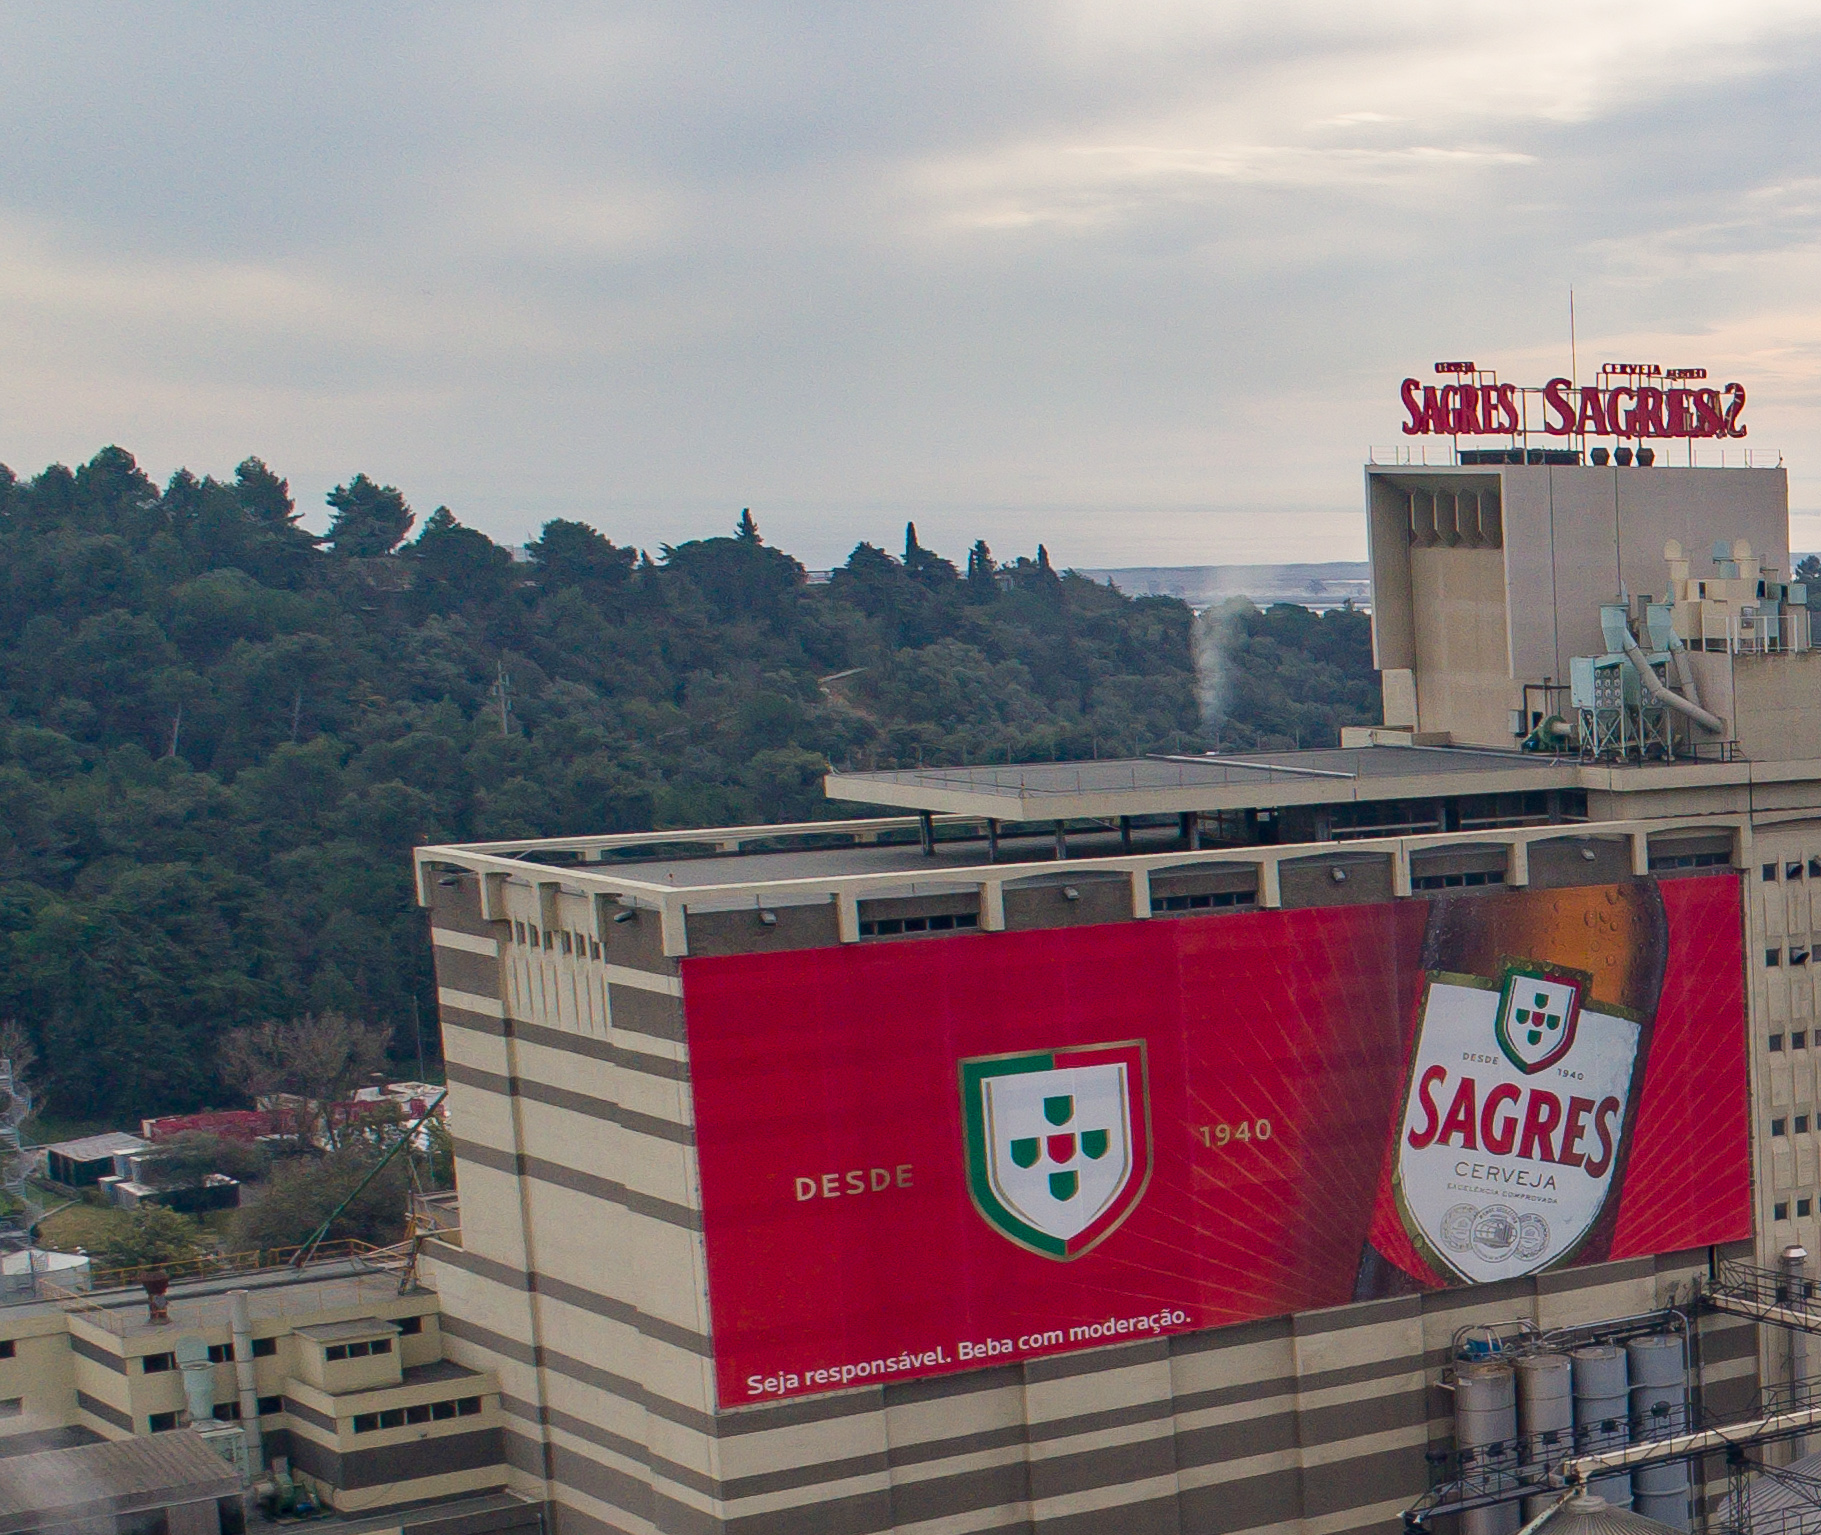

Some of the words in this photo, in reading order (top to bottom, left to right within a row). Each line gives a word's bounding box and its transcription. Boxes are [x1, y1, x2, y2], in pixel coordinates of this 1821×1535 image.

[1401, 378, 1519, 436] SAGRES
[1544, 378, 1722, 438] SAGRES
[1462, 1052, 1499, 1065] DESDE
[1556, 1068, 1585, 1081] 1940
[1199, 1118, 1273, 1148] 1940
[1407, 1064, 1621, 1179] SAGRES
[795, 1164, 914, 1201] DESDE
[1454, 1161, 1557, 1191] CERVEJA
[746, 1371, 800, 1395] Seja
[804, 1346, 953, 1384] responsável.
[958, 1338, 1014, 1361] Beba
[1018, 1329, 1064, 1350] com
[1068, 1307, 1192, 1342] moderação.
